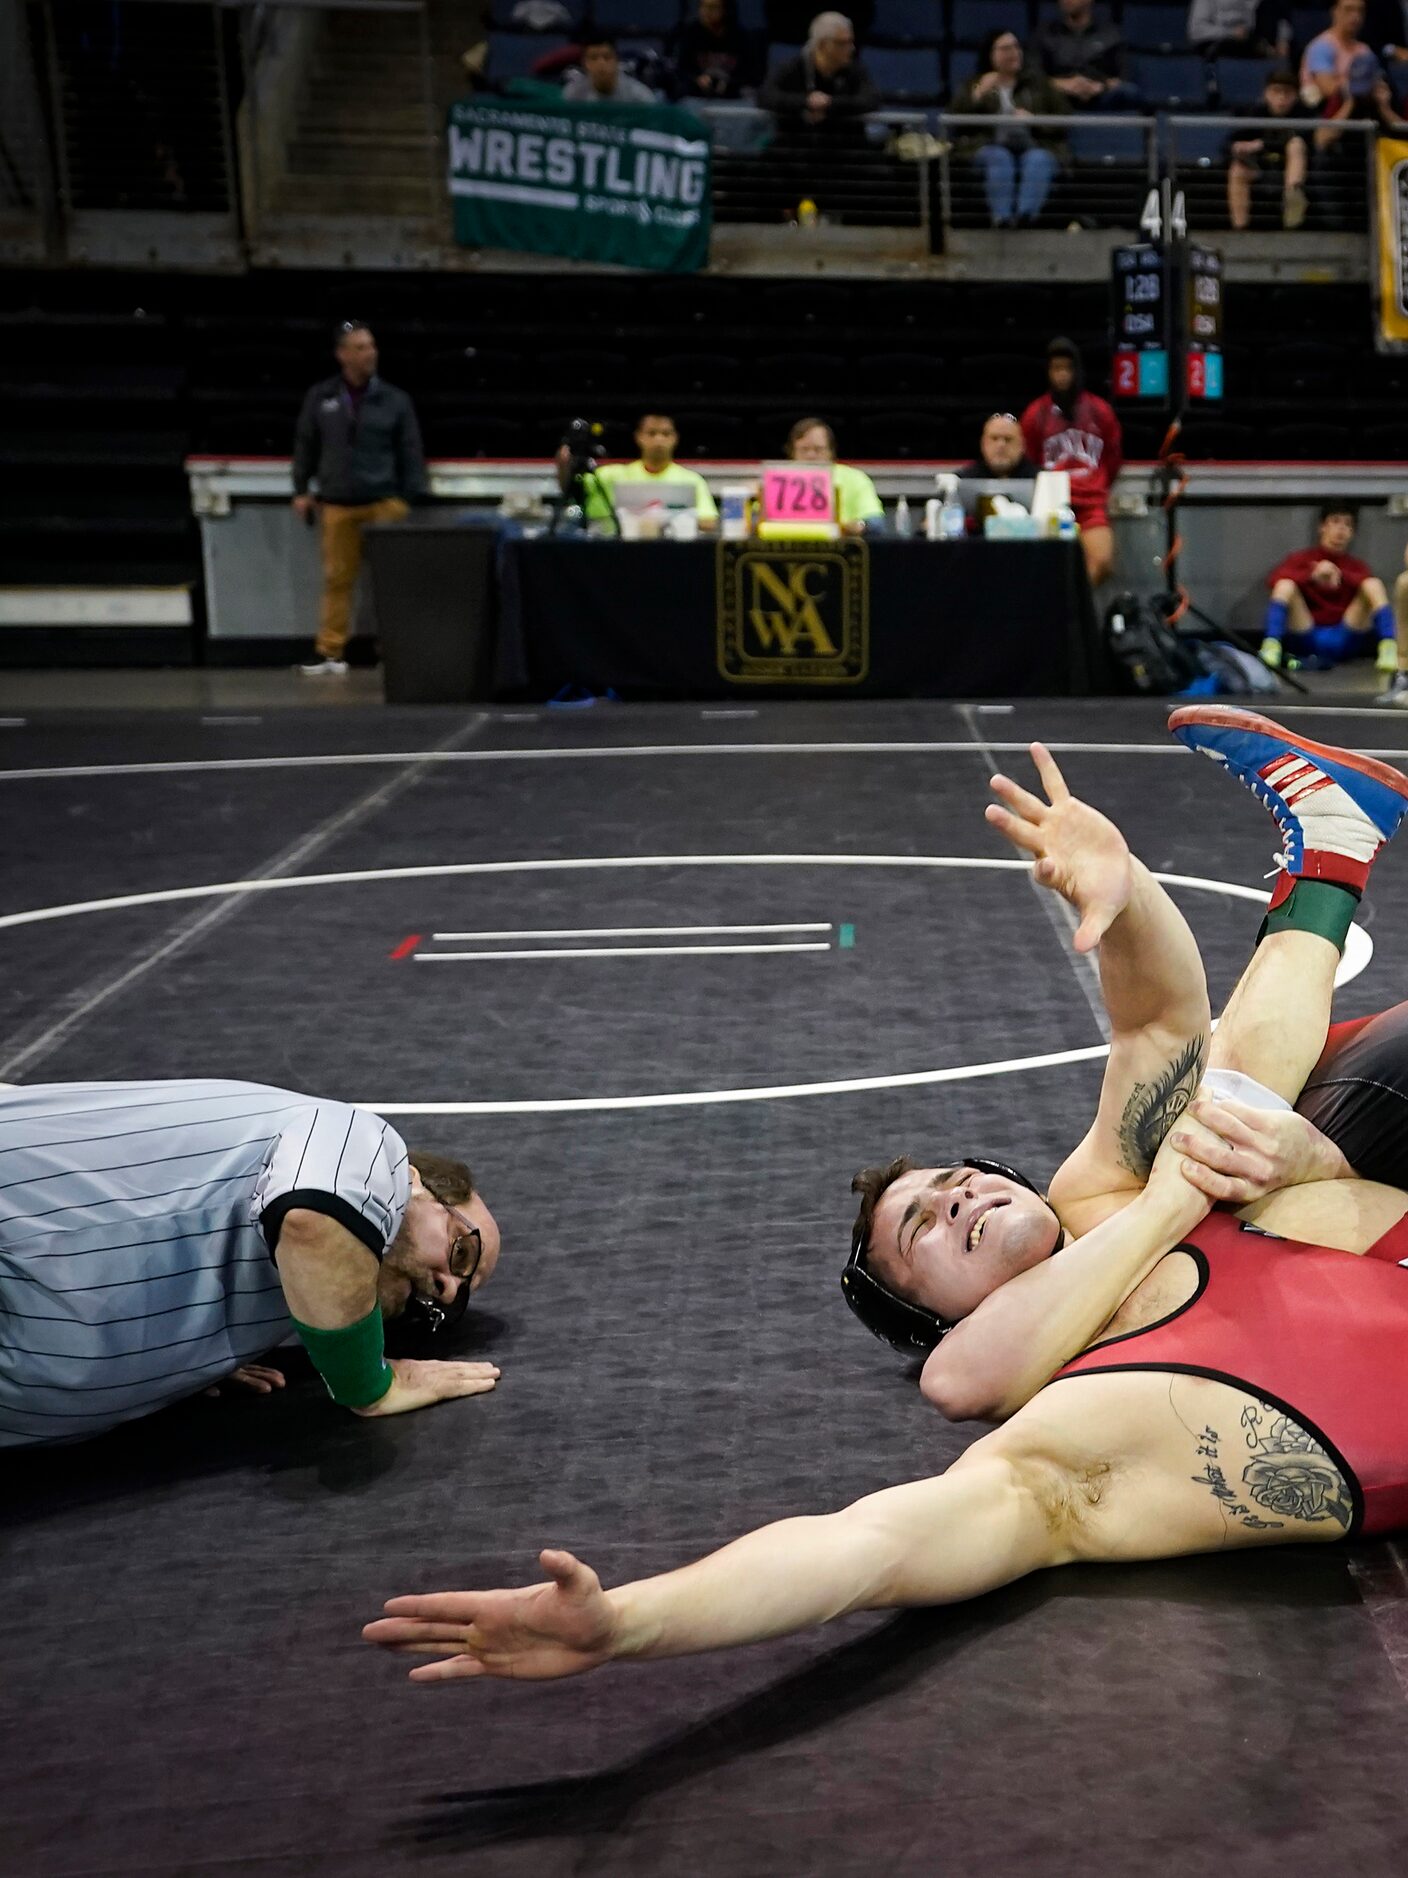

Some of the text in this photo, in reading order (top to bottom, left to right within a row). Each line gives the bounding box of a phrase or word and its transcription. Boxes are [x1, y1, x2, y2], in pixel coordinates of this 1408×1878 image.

[449, 124, 706, 205] WRESTLING
[1140, 189, 1162, 238] 4
[1173, 190, 1187, 238] 4
[1118, 359, 1136, 389] 2
[771, 475, 829, 512] 728
